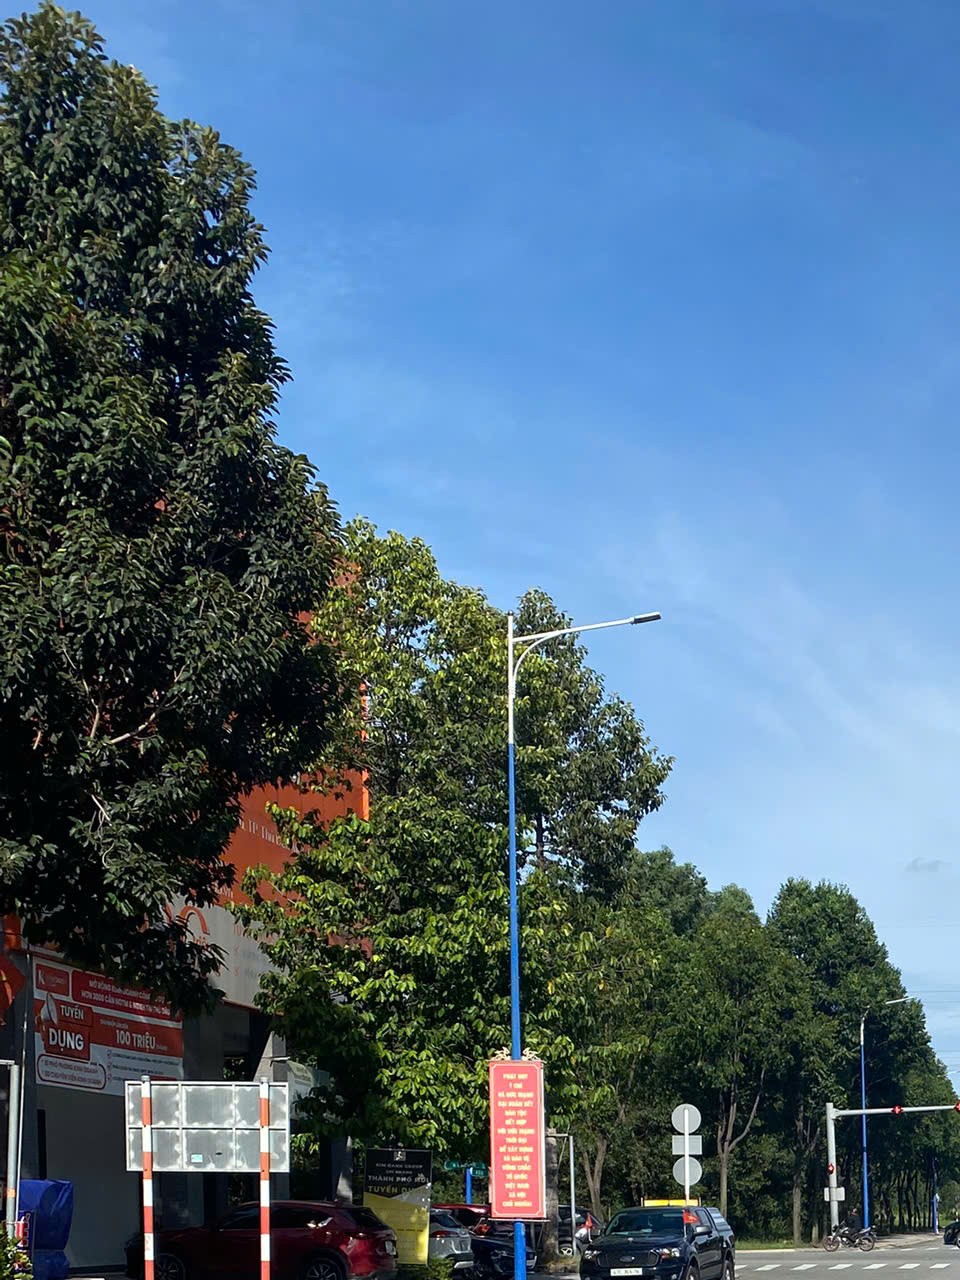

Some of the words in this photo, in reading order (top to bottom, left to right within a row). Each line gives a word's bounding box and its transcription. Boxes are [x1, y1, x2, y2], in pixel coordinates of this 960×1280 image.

[60, 1005, 84, 1020] TUYỂN
[49, 1028, 84, 1052] DỤNG
[116, 1029, 131, 1046] 100
[132, 1032, 156, 1052] TRIỆU
